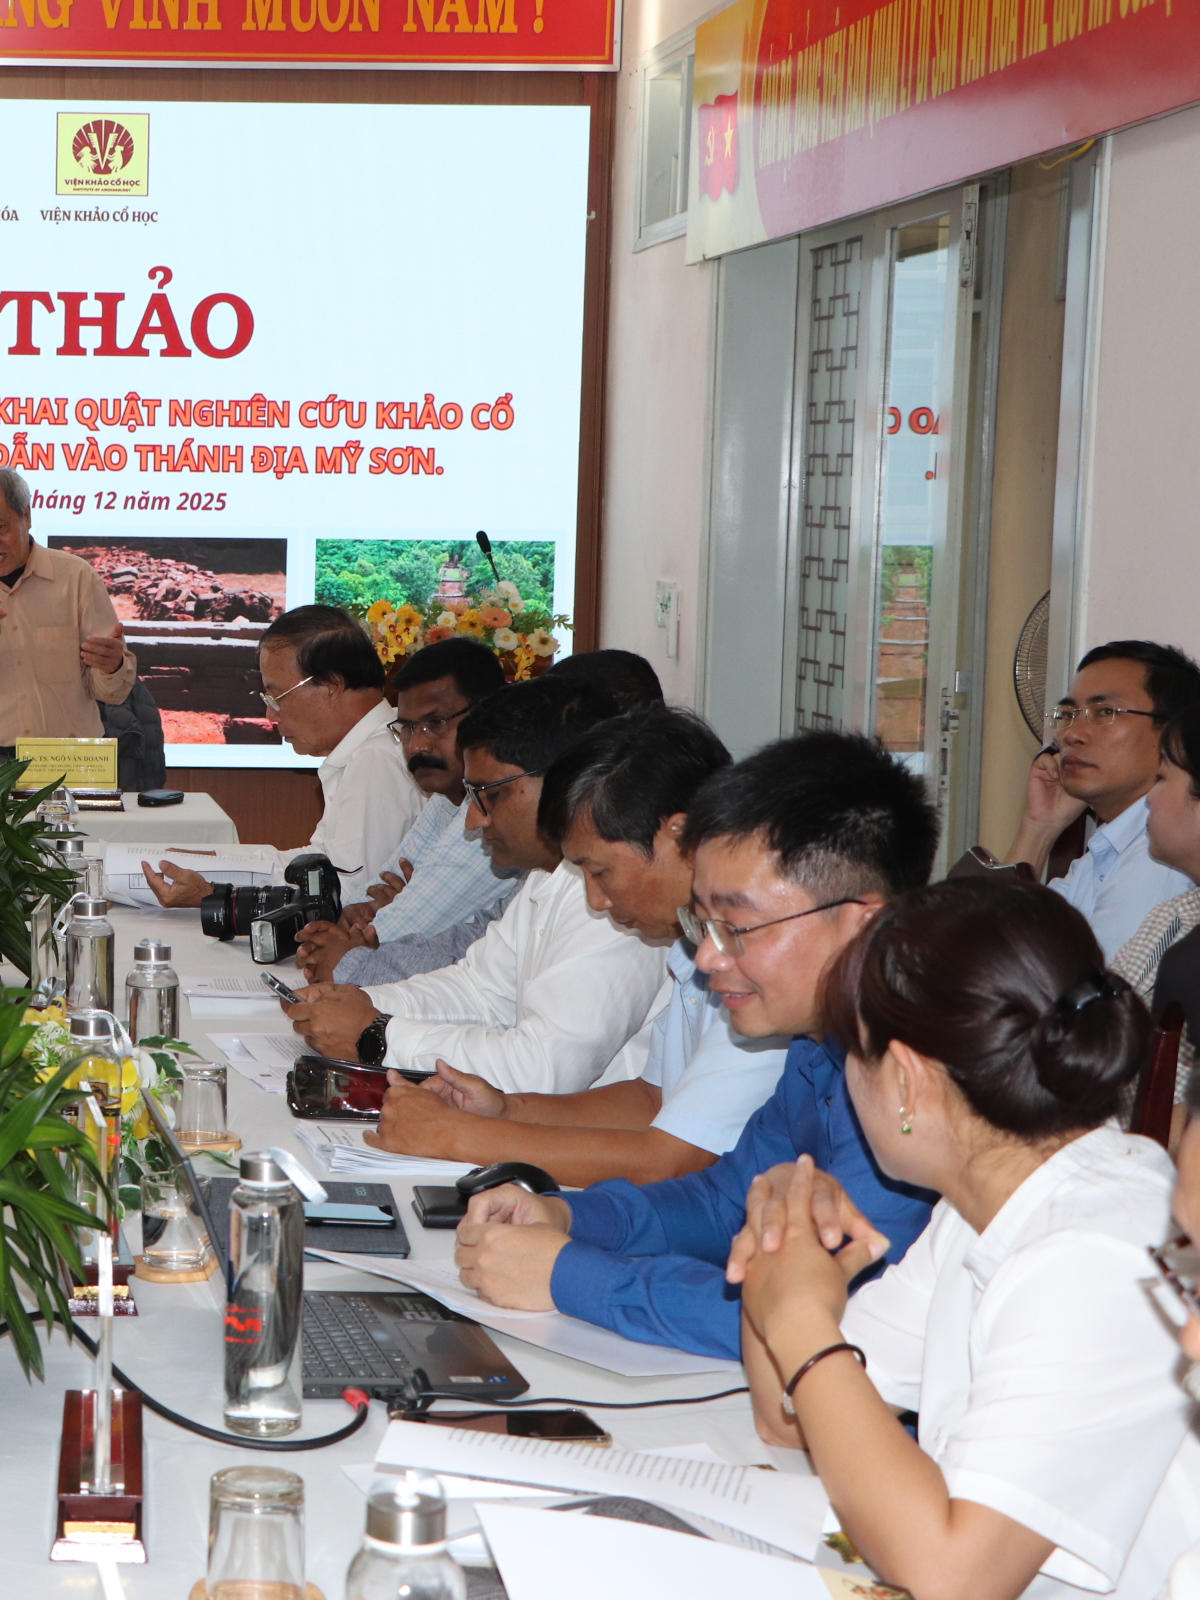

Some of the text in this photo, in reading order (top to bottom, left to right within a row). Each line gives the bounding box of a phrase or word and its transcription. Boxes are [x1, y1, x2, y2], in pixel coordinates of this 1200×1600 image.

[64, 177, 84, 187] VIỆN
[85, 177, 109, 186] KHẢO
[40, 204, 159, 226] VIỆN KHẢO CỔ HỌC
[75, 392, 161, 432] QUẬT
[169, 393, 290, 428] NGHIÊN
[299, 394, 367, 428] CỨU
[376, 394, 463, 430] KHẢO
[471, 393, 515, 430] CỔ
[62, 437, 128, 471] VÀO
[134, 438, 243, 473] THÁNH
[251, 446, 308, 480] ĐỊA
[315, 440, 364, 475] MỸ
[369, 444, 444, 475] SƠN.
[31, 490, 86, 514] háng
[93, 491, 117, 510] 12
[123, 490, 171, 511] năm
[177, 492, 227, 512] 2025
